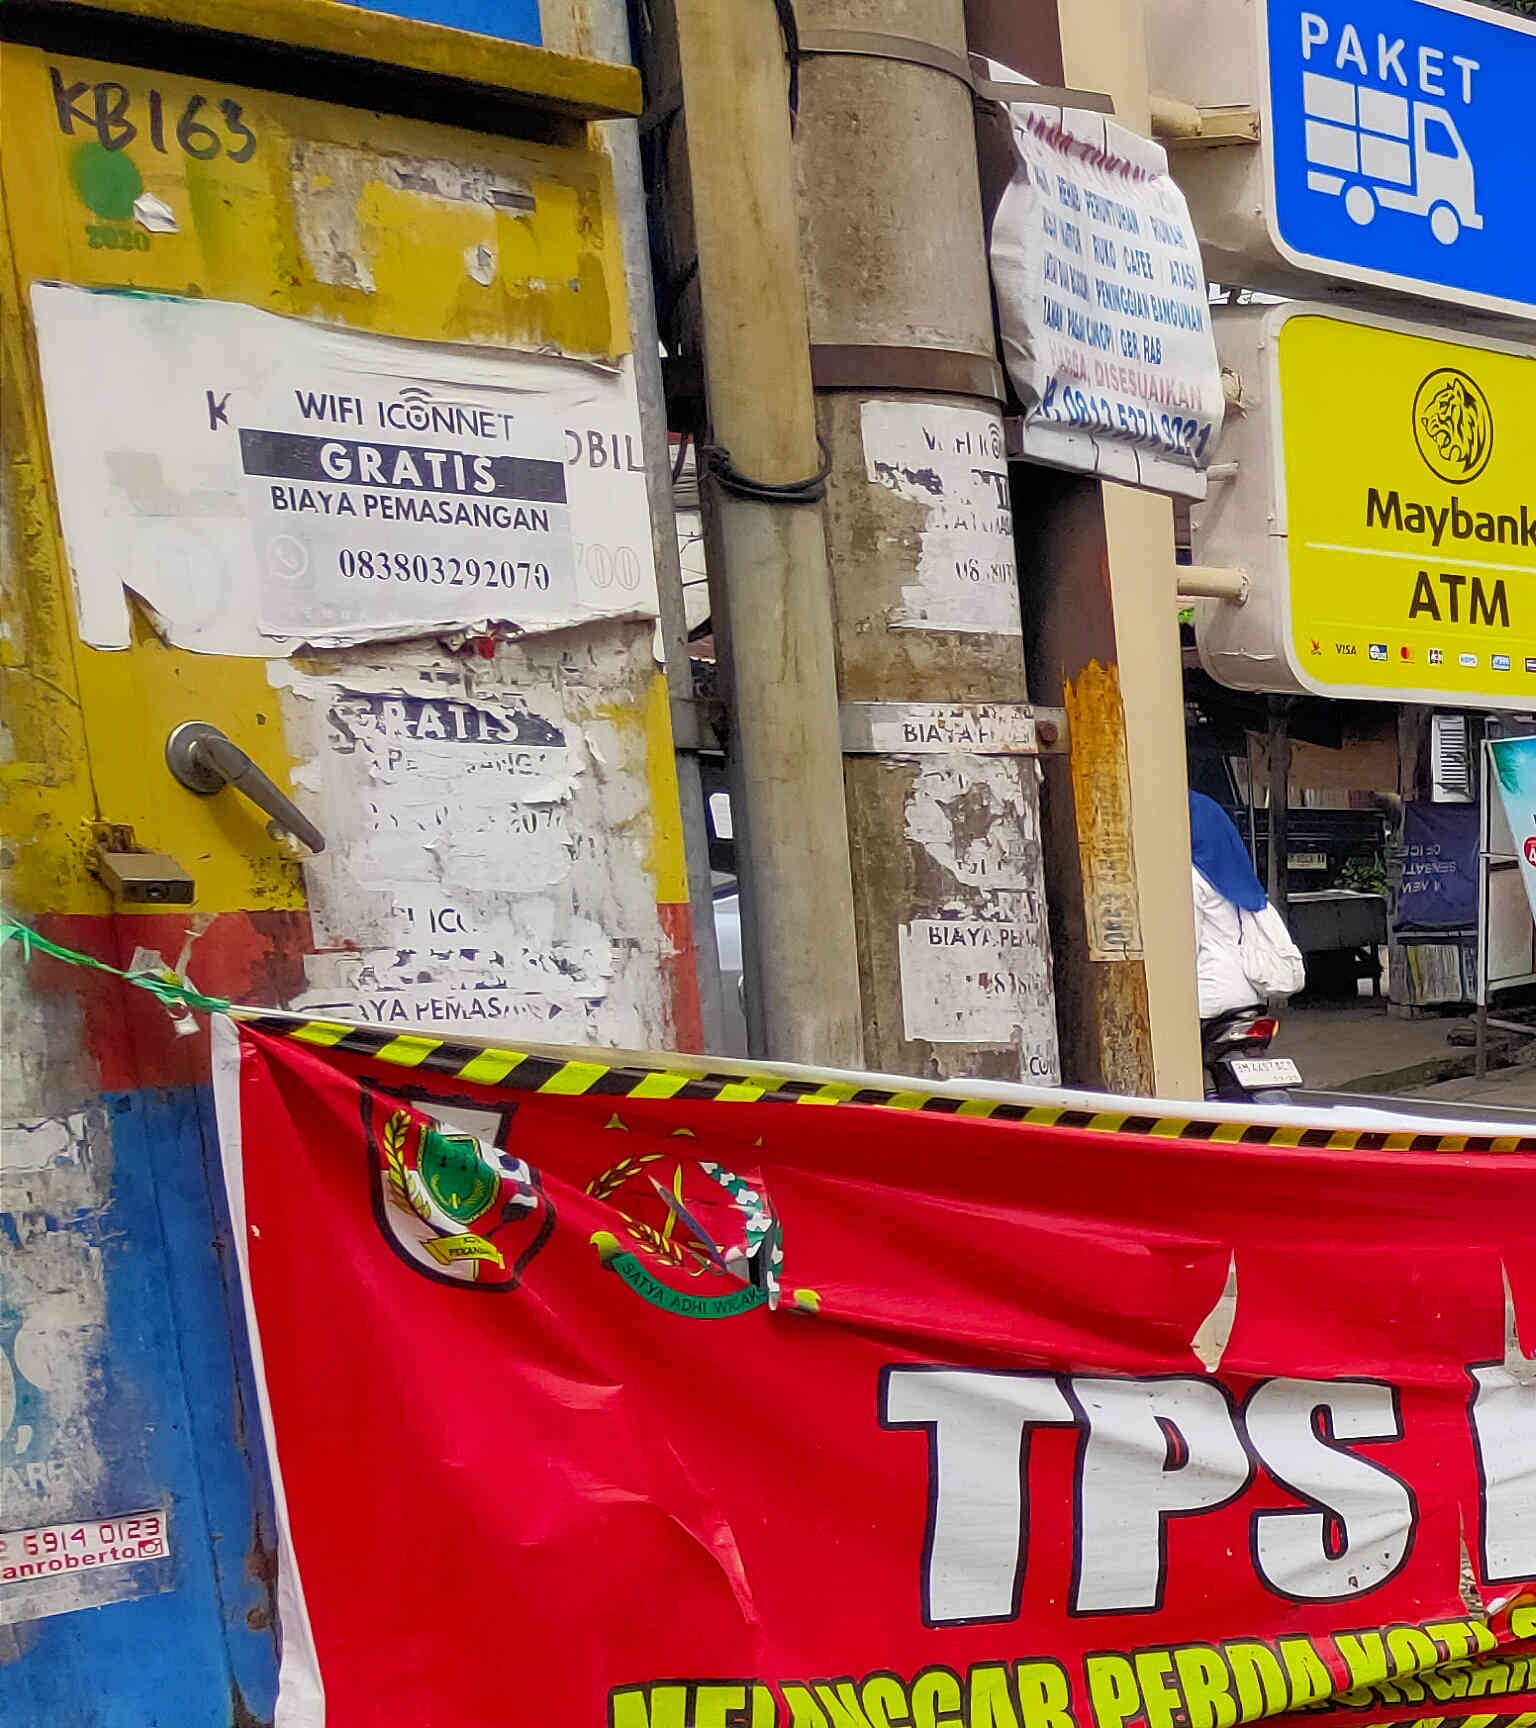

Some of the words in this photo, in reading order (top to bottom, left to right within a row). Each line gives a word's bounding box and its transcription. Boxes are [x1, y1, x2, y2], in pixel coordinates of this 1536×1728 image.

[1300, 12, 1482, 104] PAKET
[49, 67, 257, 165] KB163
[295, 390, 364, 425] WIFI
[319, 441, 498, 494] GRATIS
[271, 486, 357, 517] BIAYA
[363, 492, 549, 533] PEMASANGAN
[338, 548, 549, 590] 083803292070
[1408, 569, 1511, 629] ATM
[880, 1364, 1419, 1626] TPS
[2, 1546, 135, 1580] anroberto
